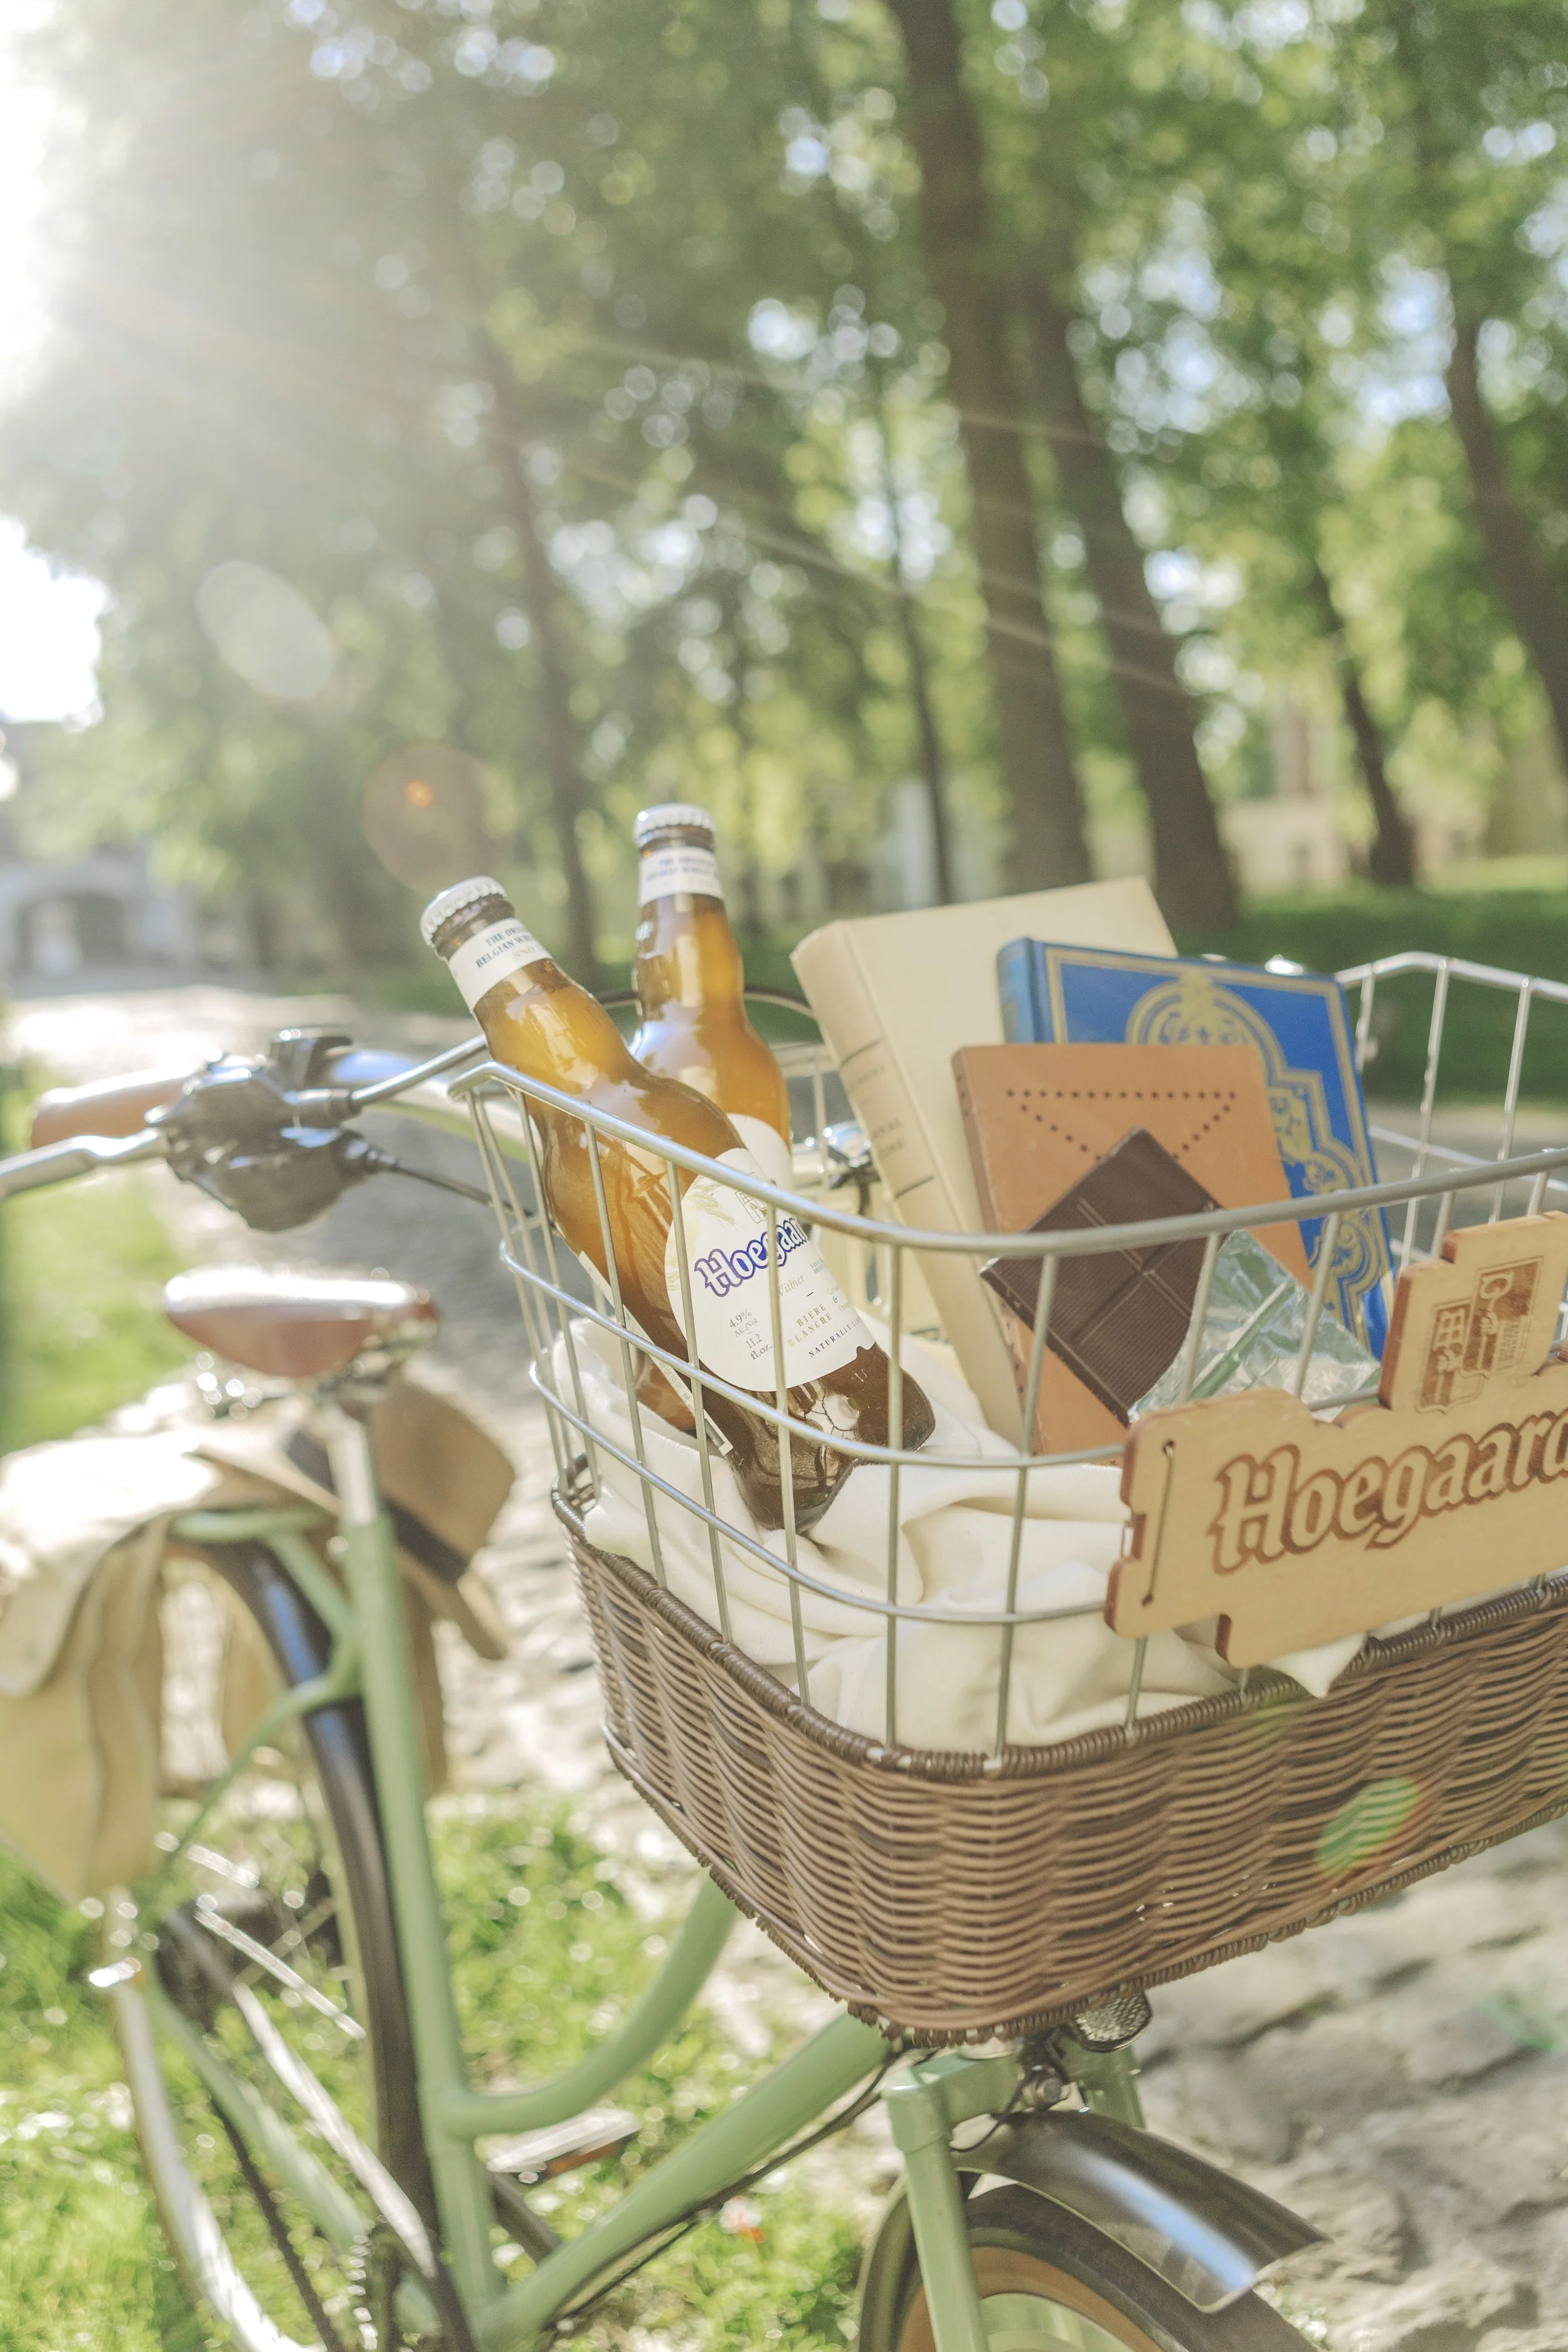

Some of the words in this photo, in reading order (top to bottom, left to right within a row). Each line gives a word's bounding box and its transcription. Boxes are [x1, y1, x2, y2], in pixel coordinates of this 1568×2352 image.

[485, 932, 506, 946] THE
[475, 940, 515, 968] BELGIAN
[729, 1308, 753, 1328] 4.9%
[788, 1313, 832, 1347] BLANCHE
[746, 1333, 763, 1348] 11.2
[808, 1323, 852, 1358] NATURALLY
